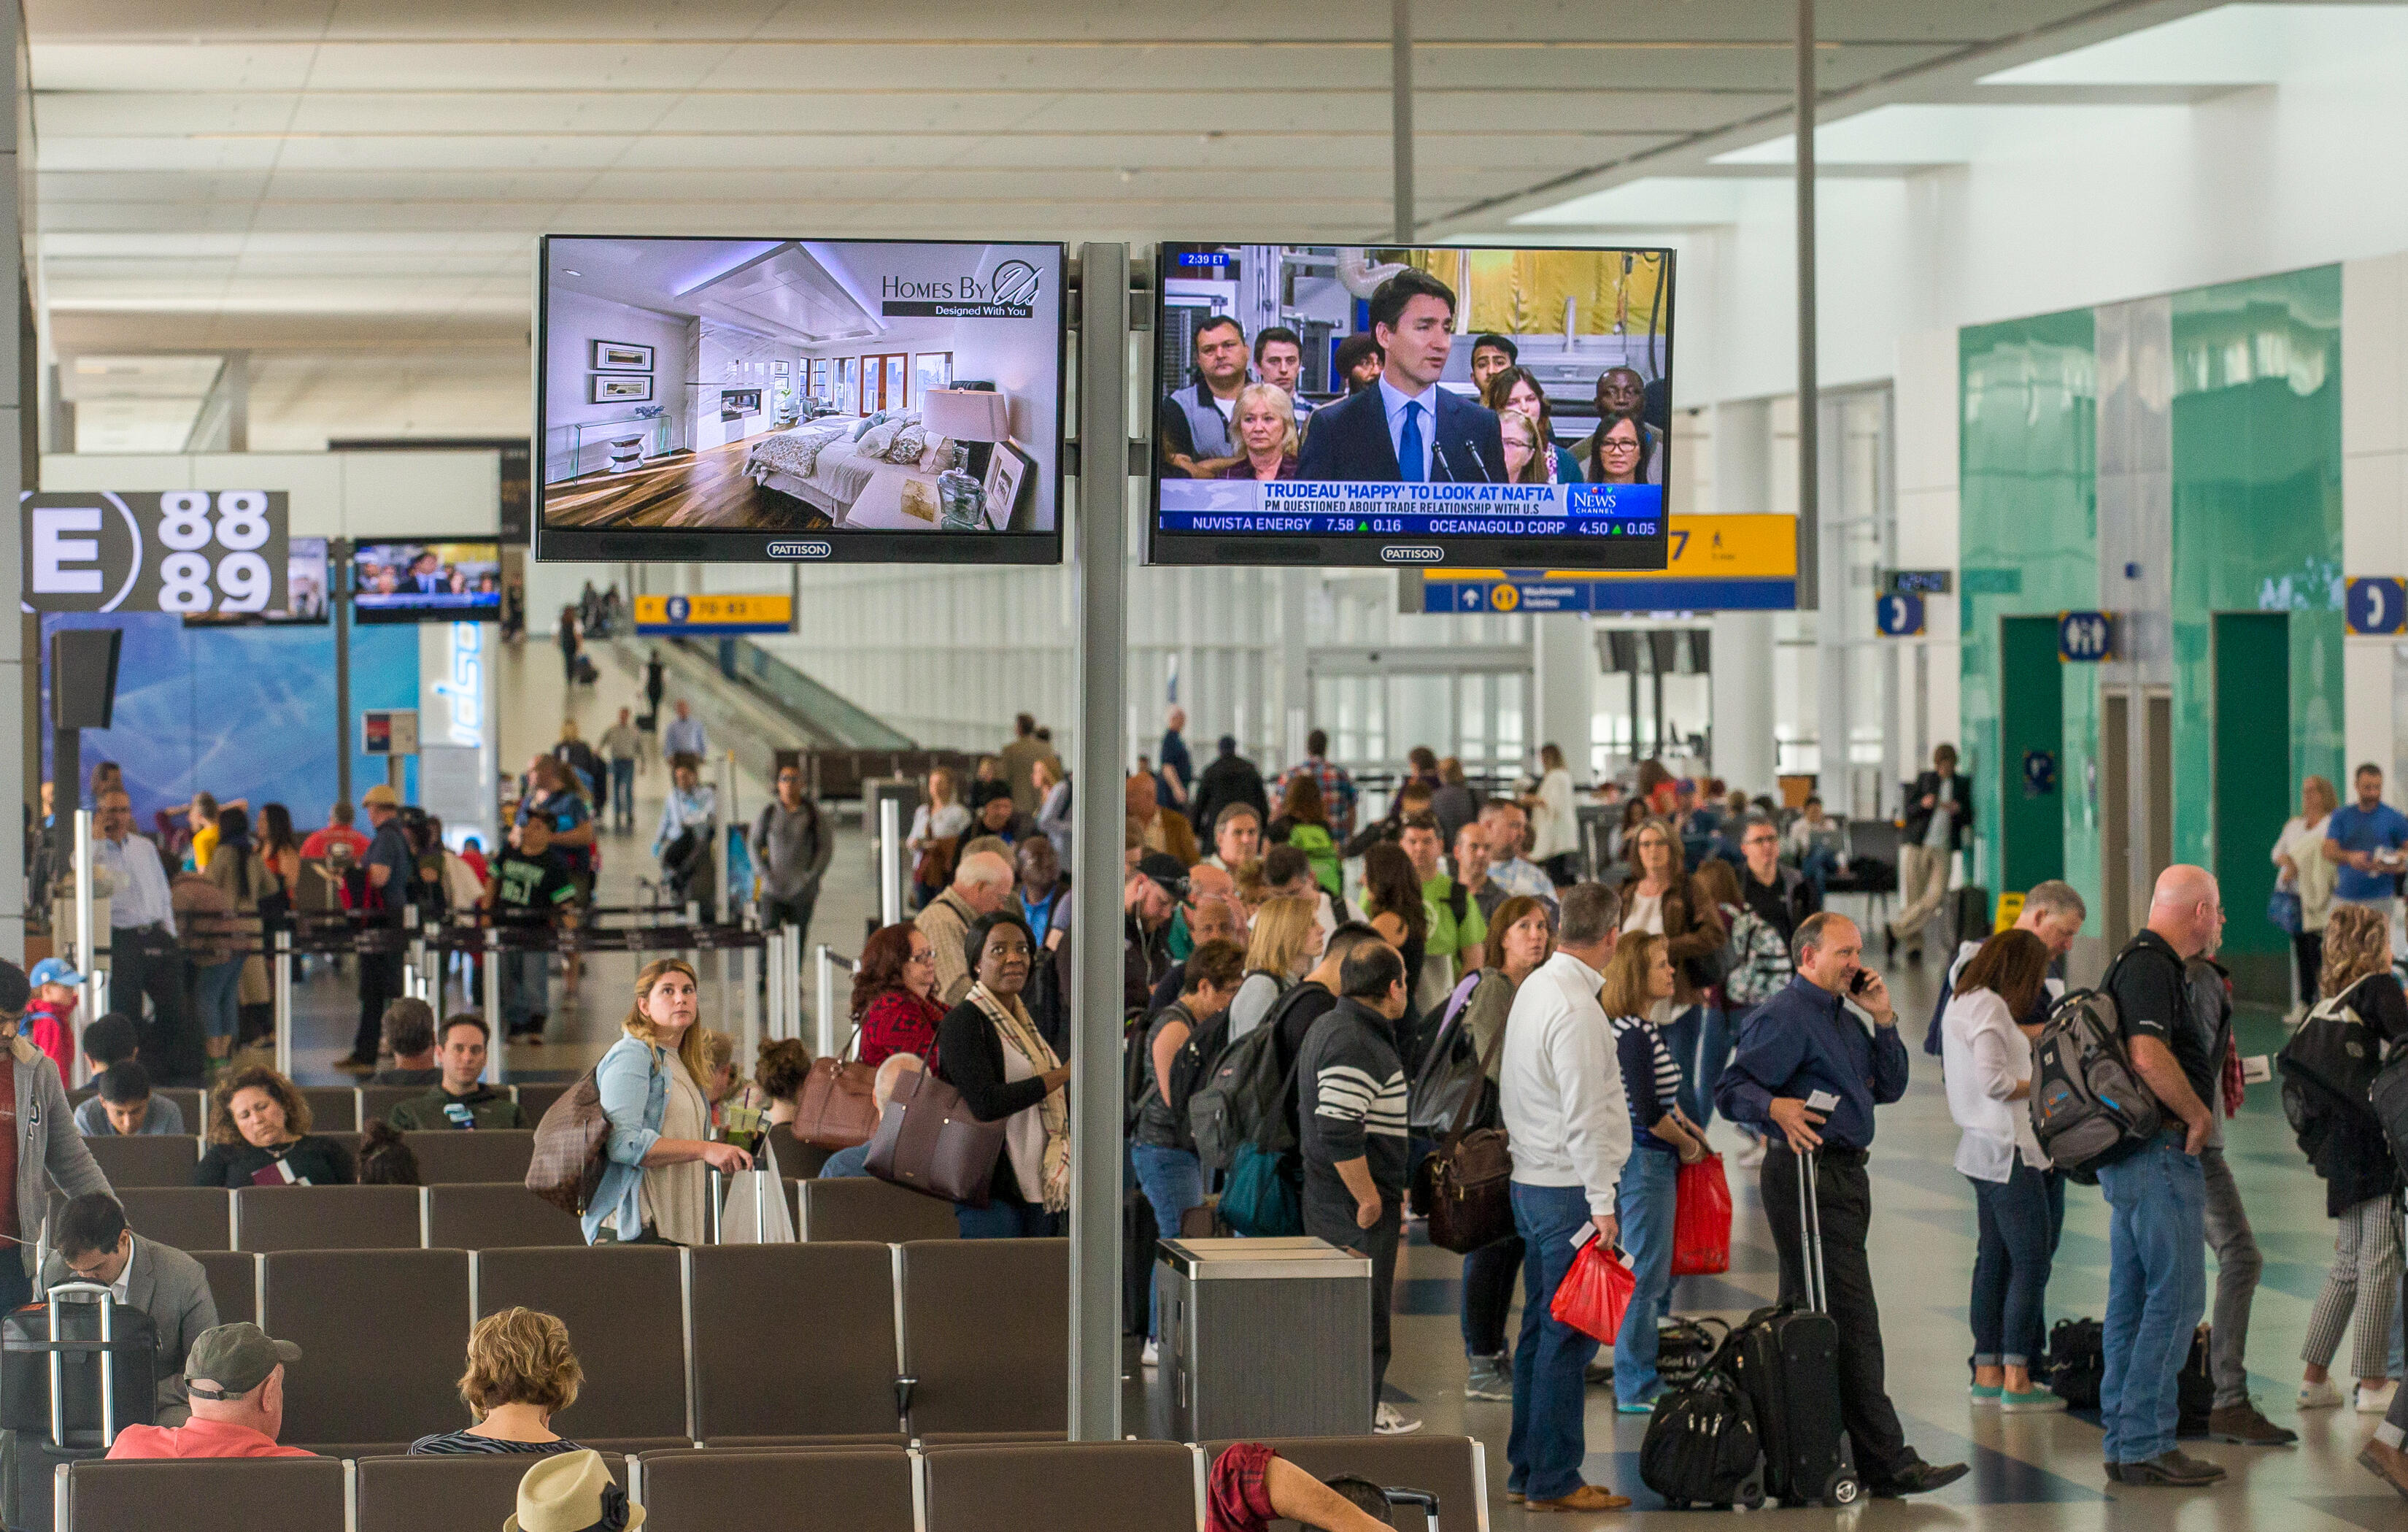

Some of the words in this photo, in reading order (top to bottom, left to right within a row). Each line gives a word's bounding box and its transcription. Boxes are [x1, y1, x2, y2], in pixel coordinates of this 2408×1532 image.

[1188, 254, 1209, 263] 2:39
[1213, 255, 1224, 263] ET
[882, 275, 953, 299] HOMES
[935, 305, 981, 316] Designed
[983, 306, 1005, 316] With
[1007, 307, 1026, 316] You
[1265, 483, 1340, 499] TRUDEAU
[1344, 484, 1405, 499] 'HAPPY'
[1409, 485, 1429, 499] TO
[1432, 485, 1475, 501] LOOK
[1478, 486, 1506, 501] AT
[1508, 487, 1555, 501] NAFTA
[1574, 492, 1616, 507] NEWS
[1265, 500, 1281, 511] PM
[1284, 501, 1346, 512] QUESTIONED
[1350, 501, 1383, 512] ABOUT
[1386, 501, 1416, 512] TRADE
[1420, 502, 1492, 514] RELATIONSHIP
[1494, 504, 1520, 514] WITH
[158, 490, 271, 552] 88
[1193, 517, 1253, 530] NUVISTA
[1256, 517, 1313, 531] ENERGY
[1327, 518, 1354, 531] 7.58
[1429, 519, 1524, 534] OCEANAGOLD
[1528, 521, 1566, 534] CORP
[1579, 522, 1608, 534] 4.50
[1626, 523, 1656, 535] 0.05
[33, 507, 103, 593] E
[772, 545, 826, 555] PATTISON
[1386, 550, 1439, 558] PATTISON
[1670, 531, 1689, 561] 7
[158, 551, 271, 612] 89
